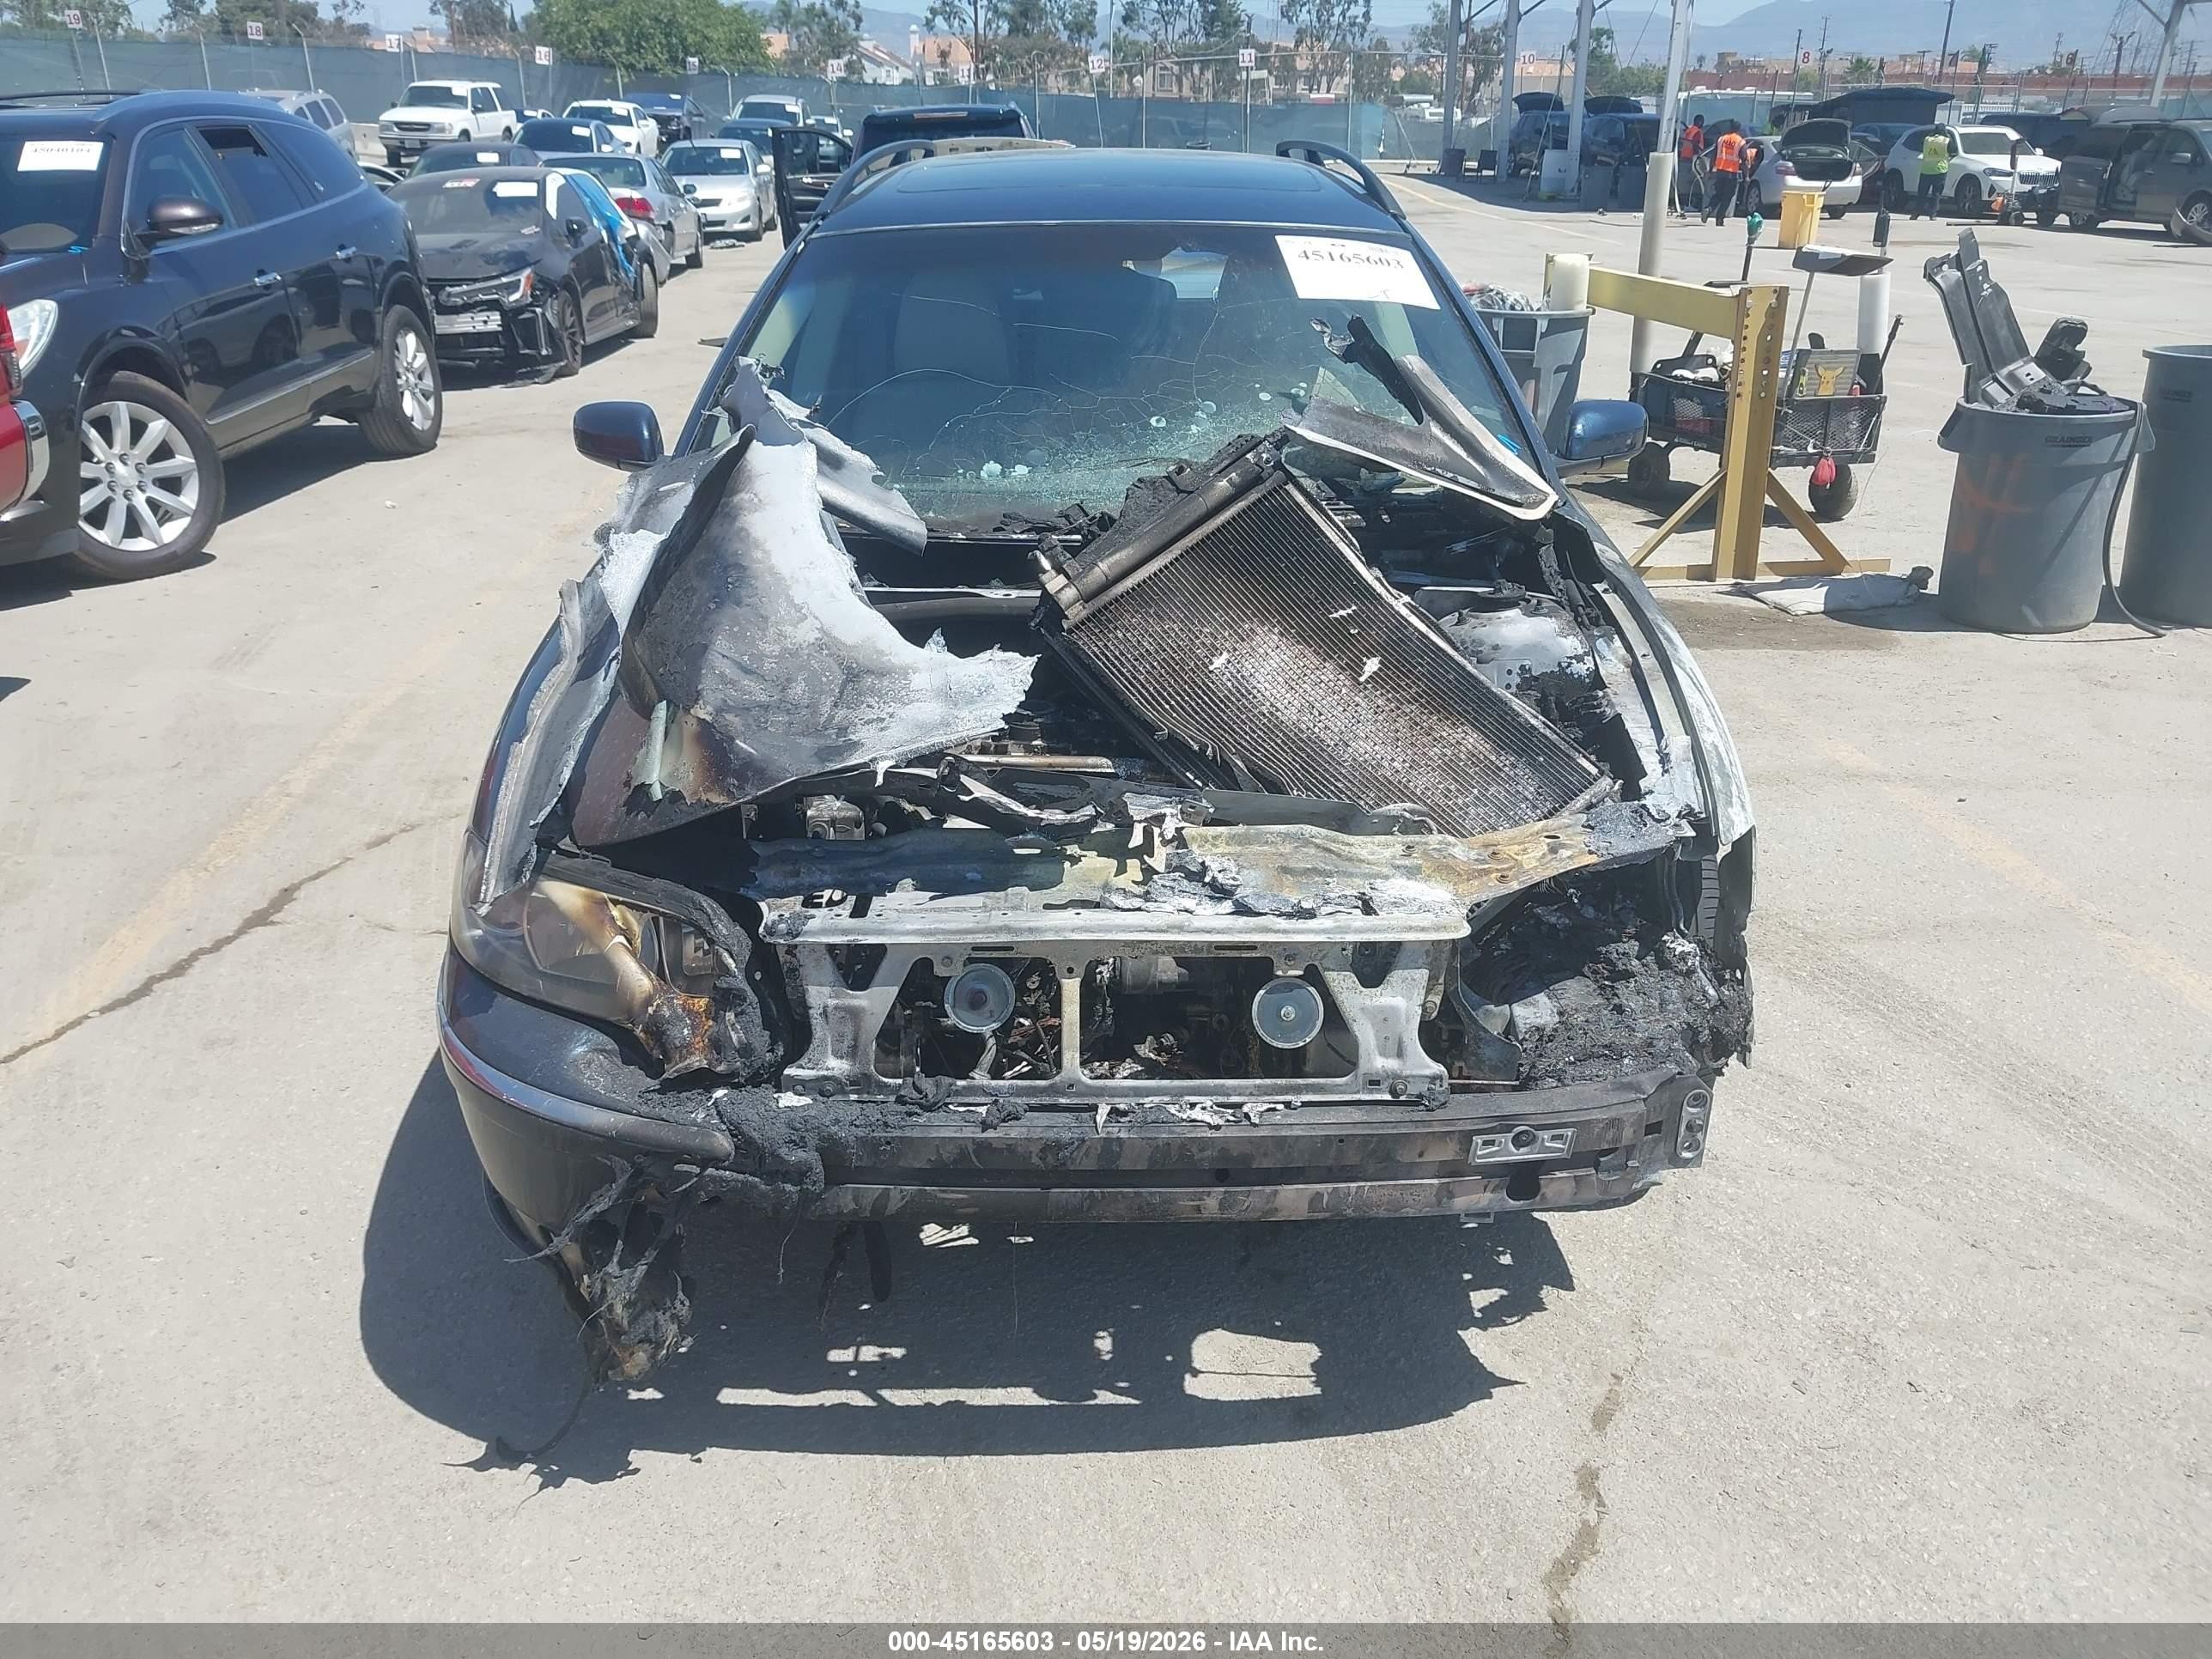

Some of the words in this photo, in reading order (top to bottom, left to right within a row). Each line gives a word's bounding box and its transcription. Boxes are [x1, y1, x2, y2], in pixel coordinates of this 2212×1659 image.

[67, 14, 81, 25] 19
[248, 25, 262, 36] 18
[388, 39, 400, 49] 17
[538, 50, 550, 61] 16
[1240, 53, 1254, 64] 11
[1521, 53, 1535, 65] 10
[1802, 52, 1810, 64] 8
[687, 60, 697, 70] 15
[830, 64, 842, 74] 14
[1091, 58, 1103, 70] 12
[1297, 248, 1405, 270] 45165603
